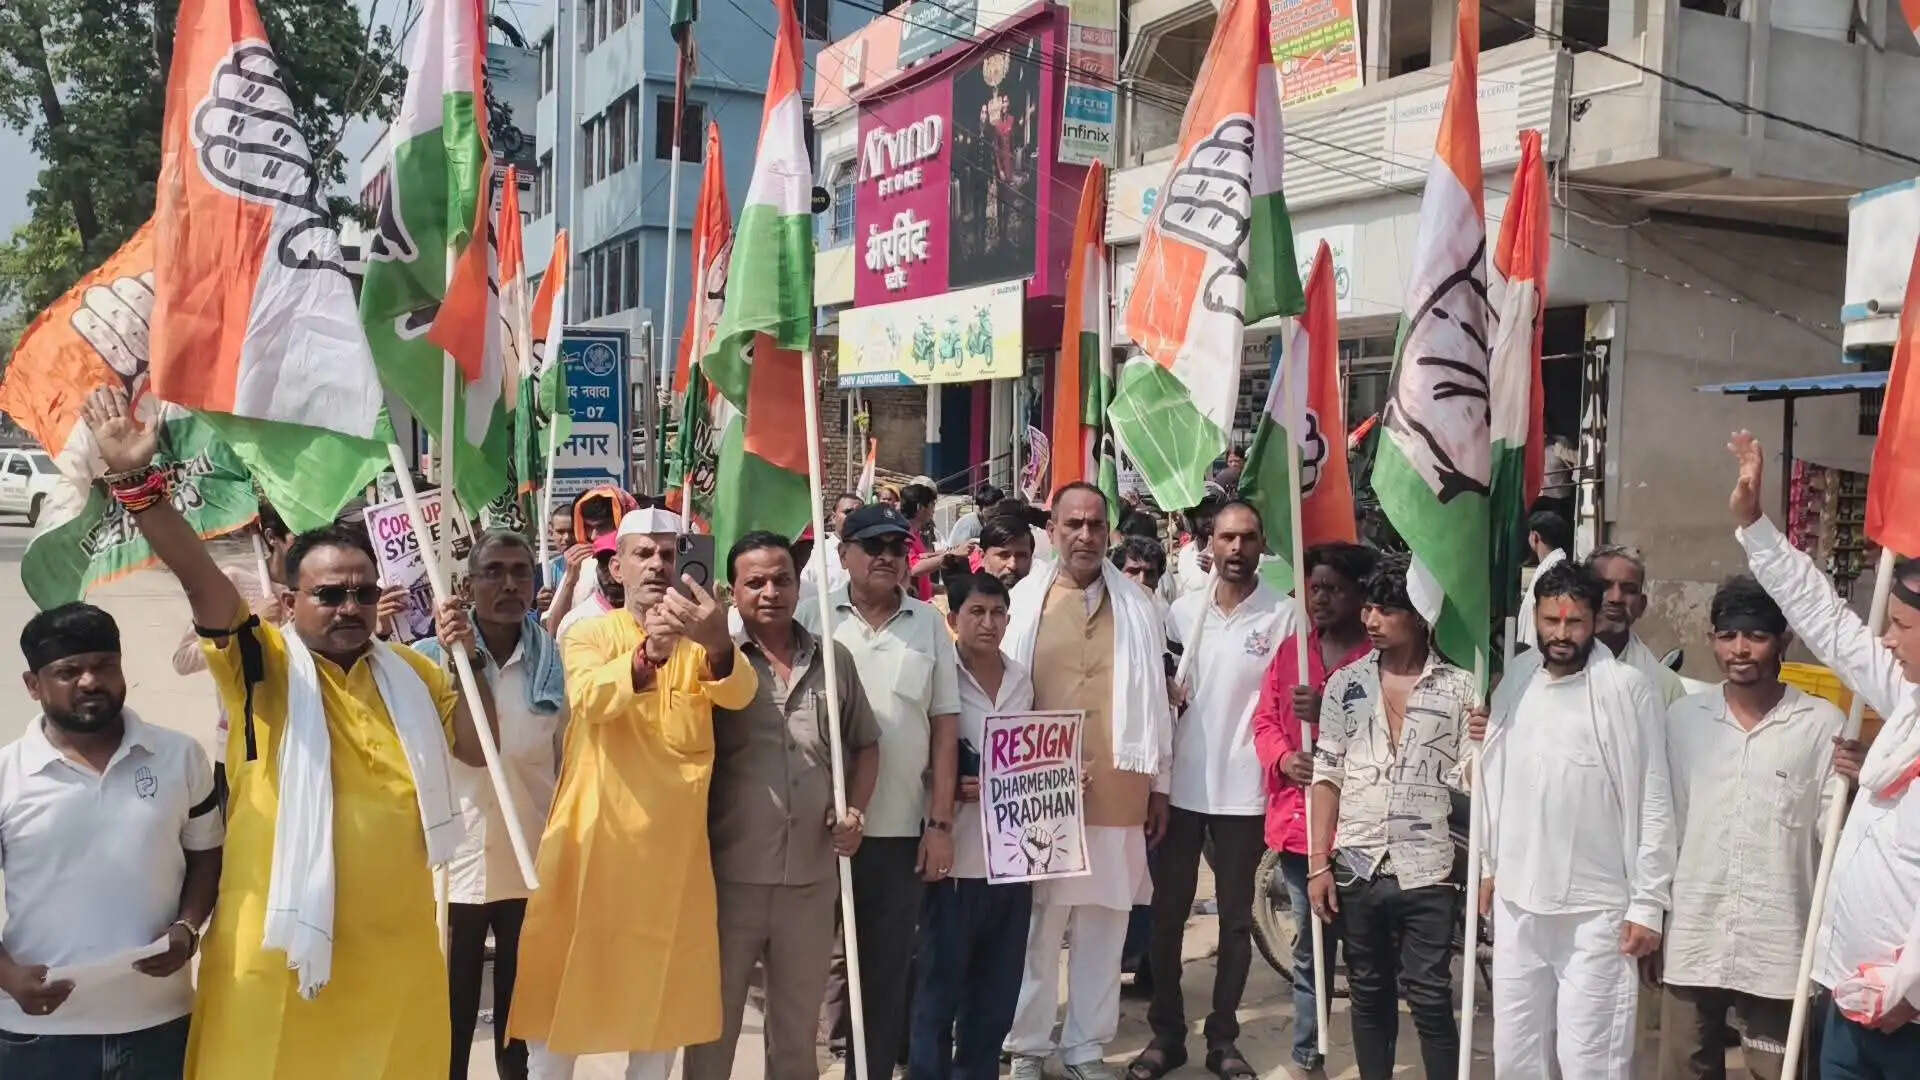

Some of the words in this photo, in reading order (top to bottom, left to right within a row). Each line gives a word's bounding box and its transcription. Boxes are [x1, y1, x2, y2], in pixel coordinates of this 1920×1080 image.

[1063, 123, 1110, 143] Infinix
[878, 166, 922, 198] STORE
[580, 385, 610, 399] नवादा
[839, 374, 855, 386] SHIV
[856, 372, 899, 385] AUTOMOBILE
[991, 722, 1076, 772] RESIGN
[990, 766, 1076, 803] DHARMENDRA
[993, 791, 1076, 833] PRADHAN
